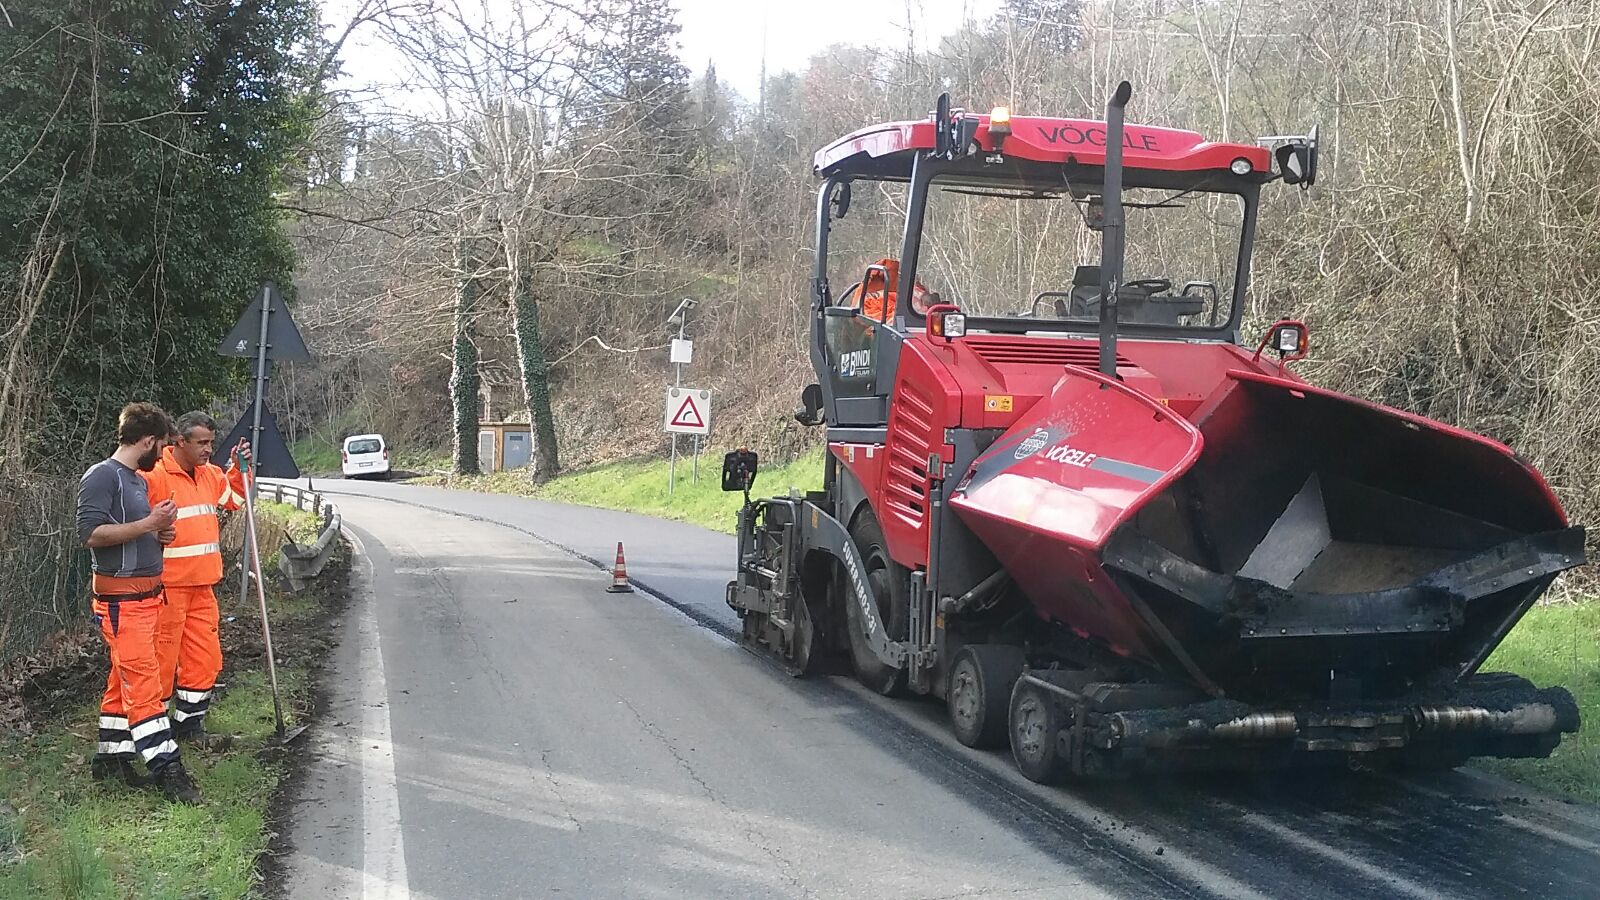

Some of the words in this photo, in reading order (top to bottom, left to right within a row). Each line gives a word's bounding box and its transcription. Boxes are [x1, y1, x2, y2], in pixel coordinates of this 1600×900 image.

[1038, 124, 1161, 152] VÖGLE
[849, 349, 871, 377] BINDI
[1045, 444, 1097, 468] VÖGELE
[842, 540, 859, 583] SUPER
